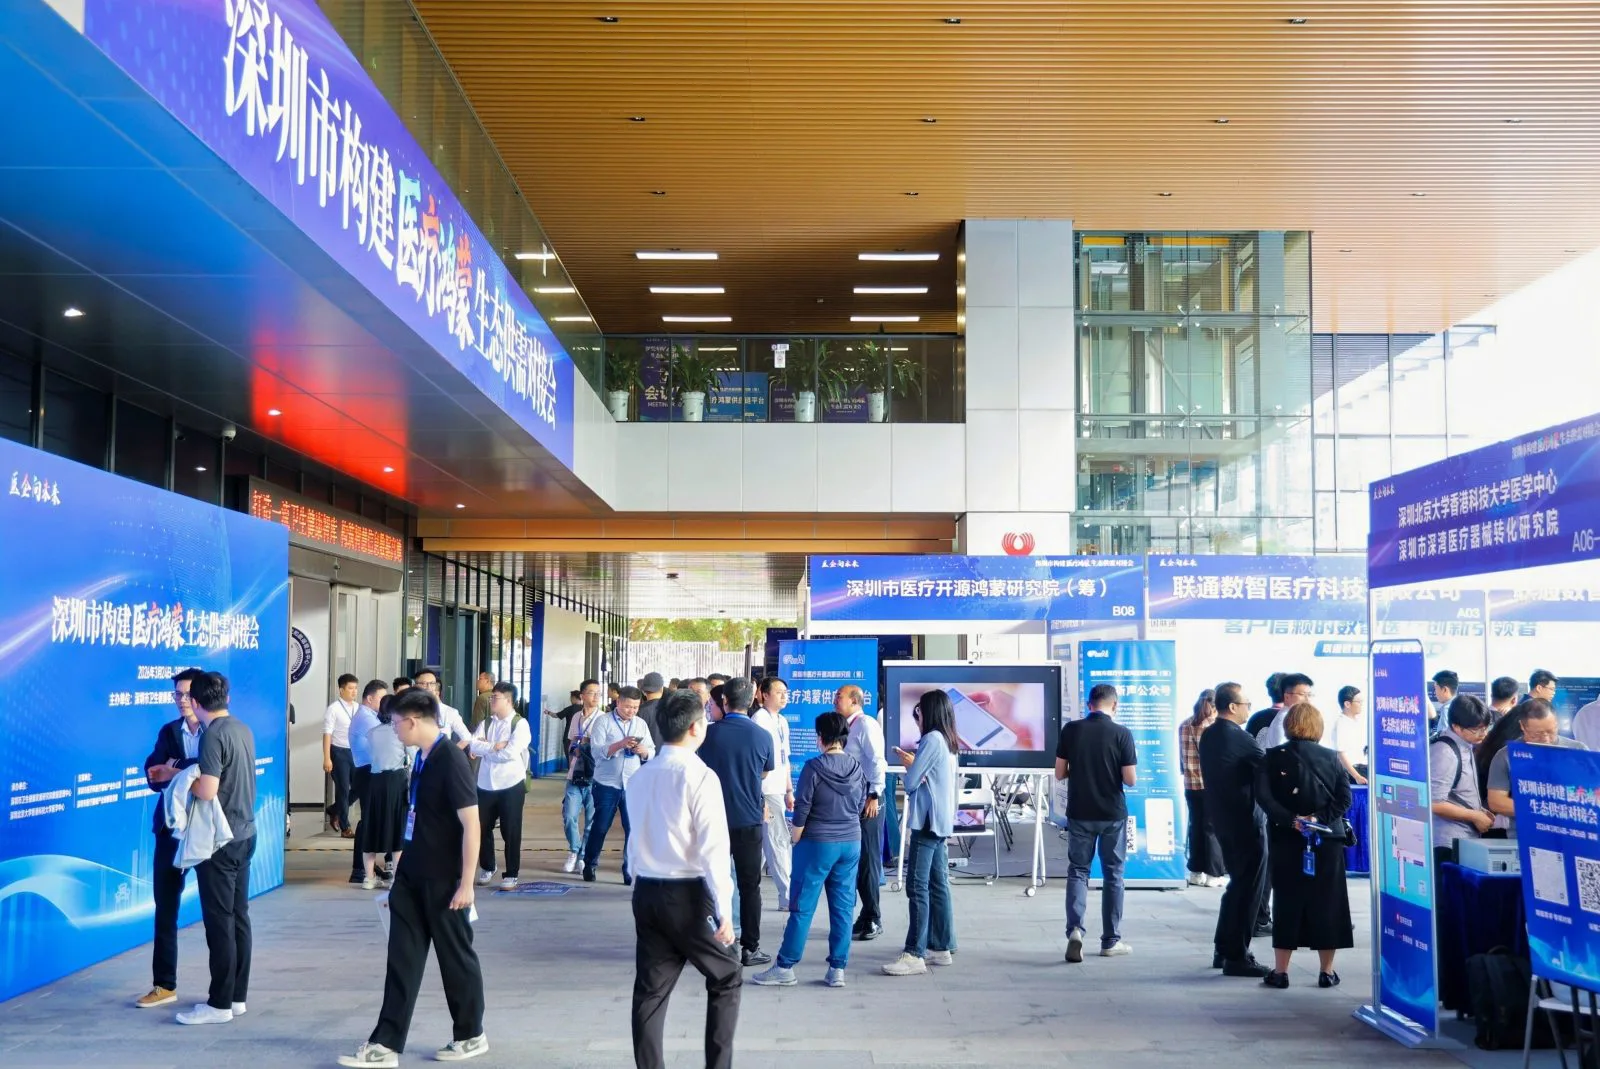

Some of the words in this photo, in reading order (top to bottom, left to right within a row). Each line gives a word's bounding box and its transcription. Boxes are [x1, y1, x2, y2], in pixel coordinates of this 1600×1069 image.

[1398, 467, 1558, 528] 深圳北京大学香港科技大学医学中心
[1398, 508, 1560, 562] 深圳市深湾医疗器械转化研究院
[1112, 605, 1136, 617] B08
[1456, 607, 1481, 619] A03
